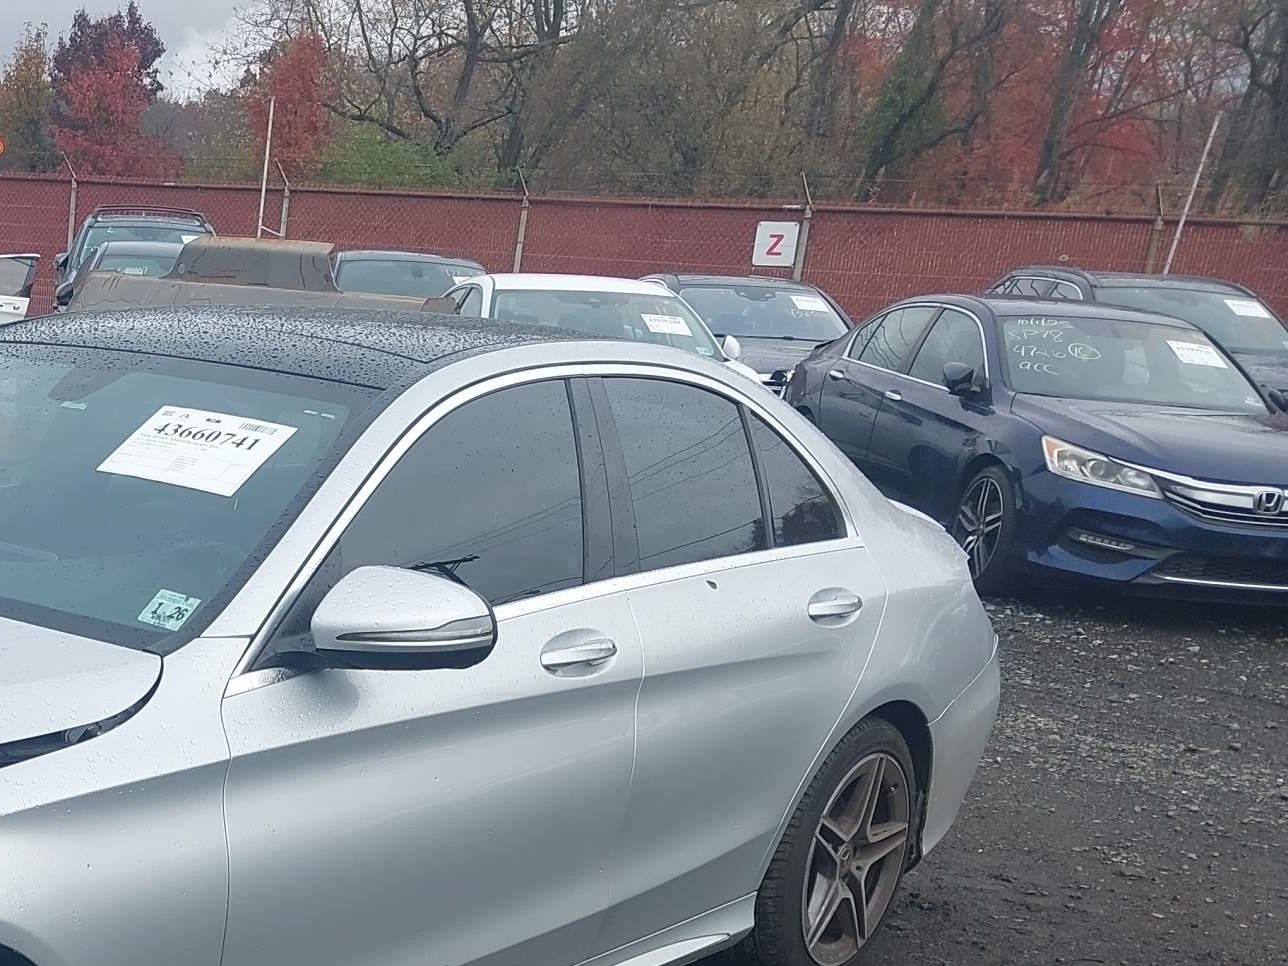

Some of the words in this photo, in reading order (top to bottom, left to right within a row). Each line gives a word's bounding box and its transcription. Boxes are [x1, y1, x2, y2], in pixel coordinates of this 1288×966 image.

[765, 234, 785, 256] Z
[153, 422, 261, 451] 43660741
[167, 606, 189, 621] 26
